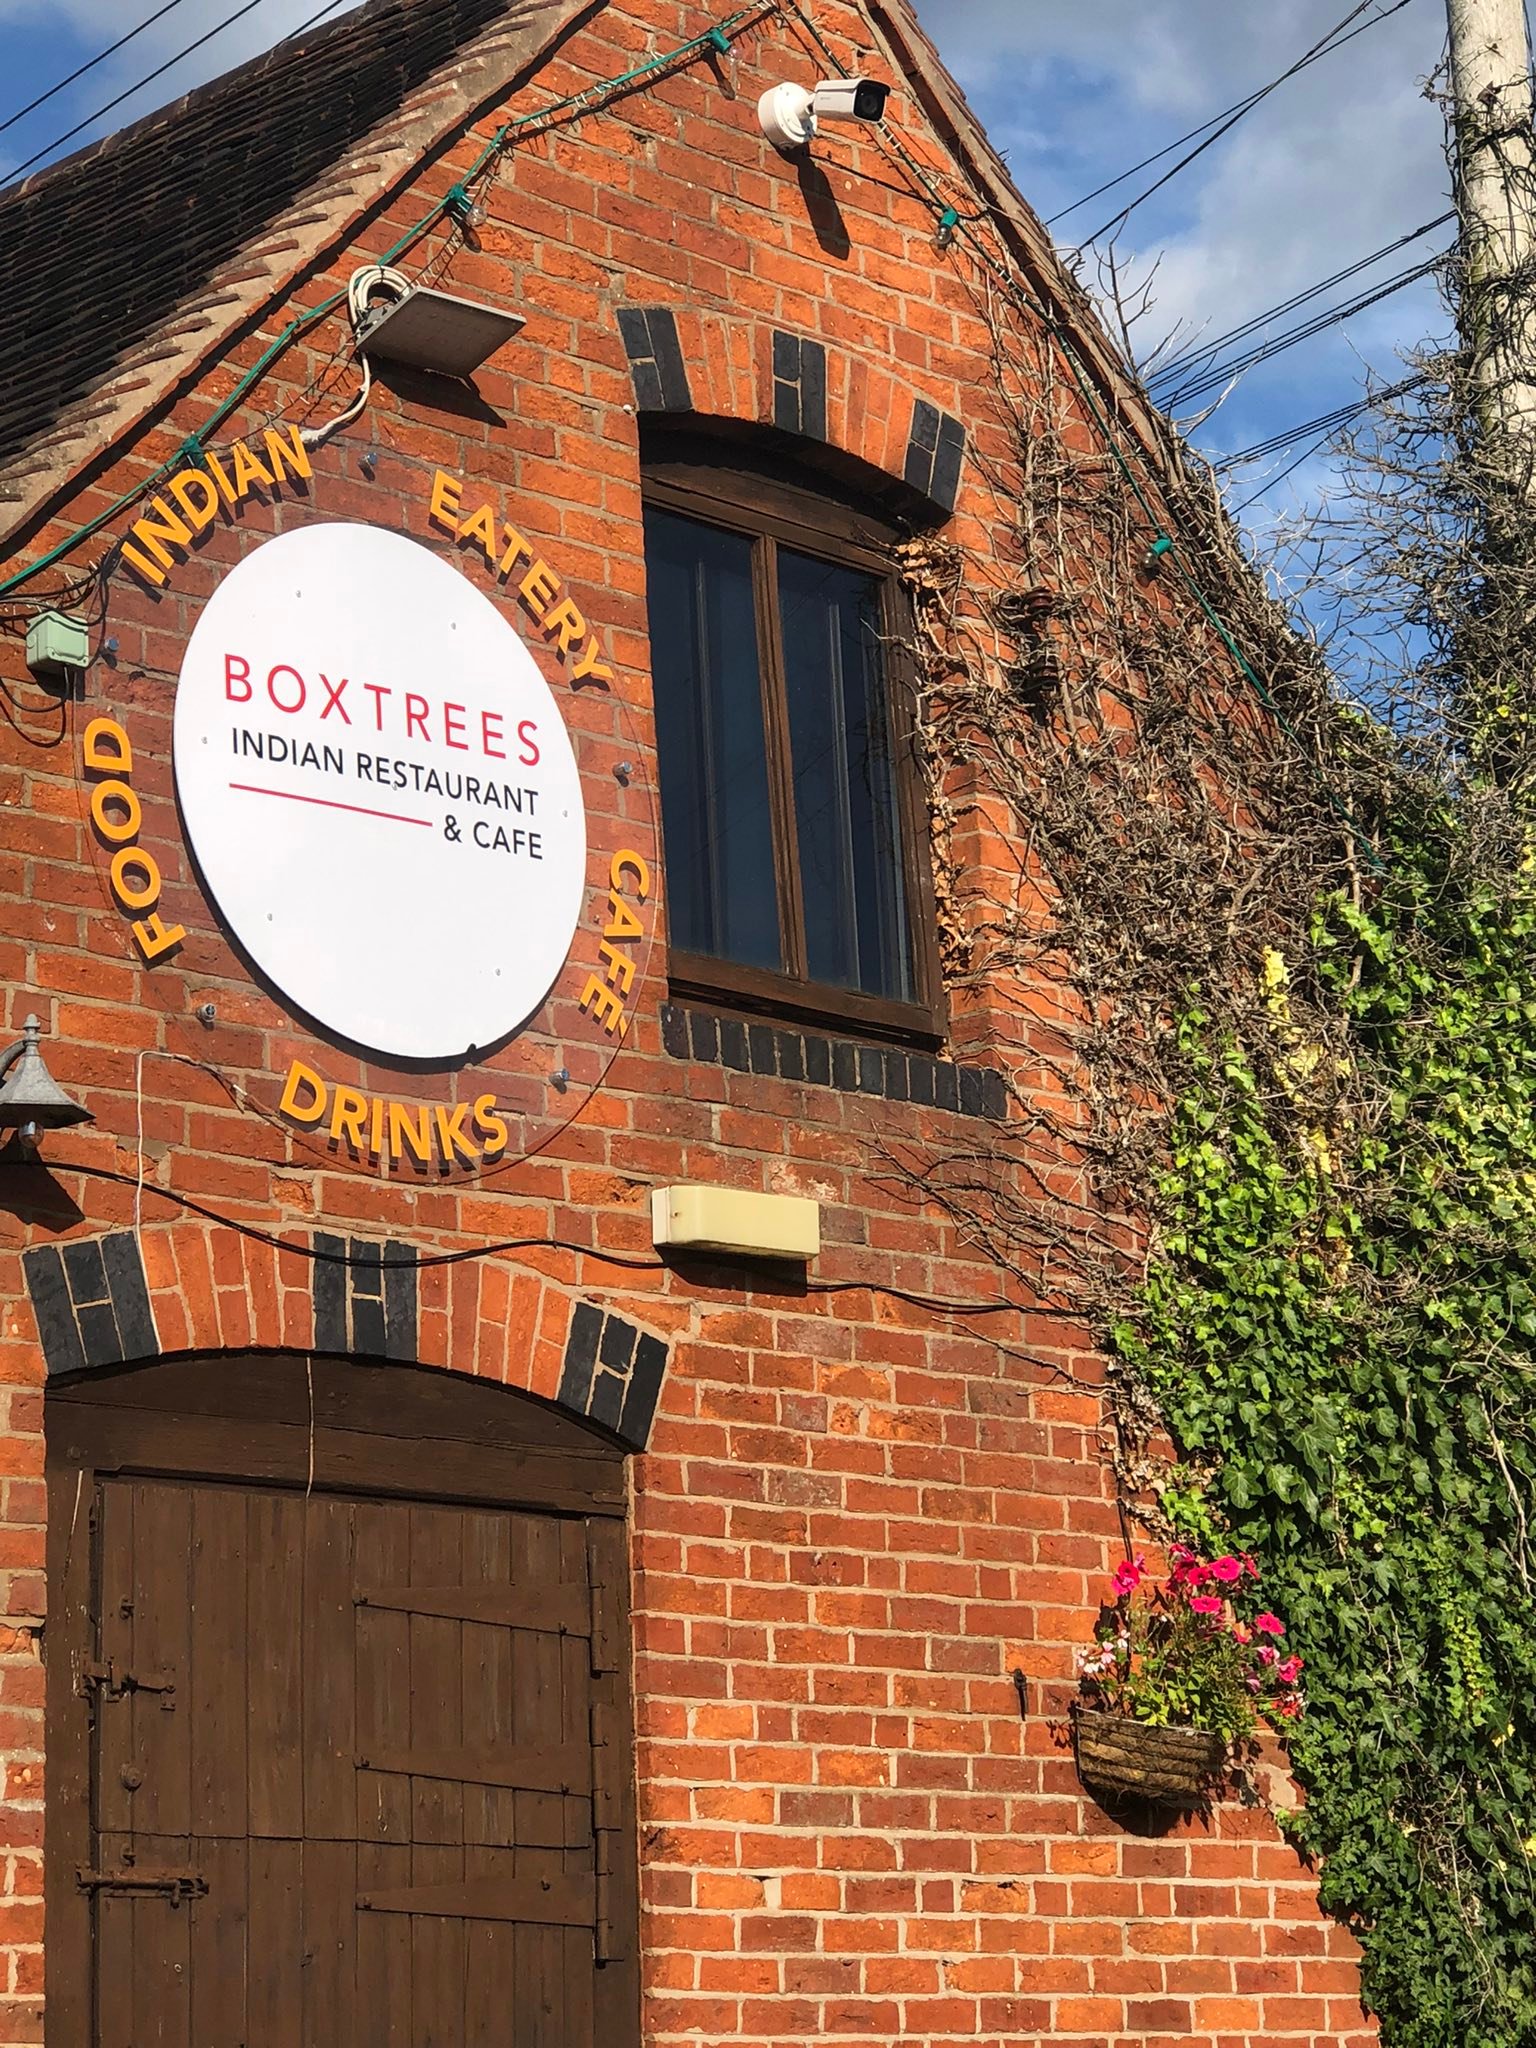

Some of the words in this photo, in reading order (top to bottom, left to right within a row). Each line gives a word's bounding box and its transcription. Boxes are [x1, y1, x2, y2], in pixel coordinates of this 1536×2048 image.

[121, 425, 313, 585] INDIAN
[430, 469, 614, 681] EATERY
[224, 653, 541, 767] BOXTREES
[232, 727, 344, 775] INDIAN
[357, 752, 539, 816] RESTAURANT
[84, 717, 187, 959] FOOD
[443, 813, 463, 843] &
[473, 821, 543, 860] CAFE
[280, 1060, 508, 1161] DRINKS
